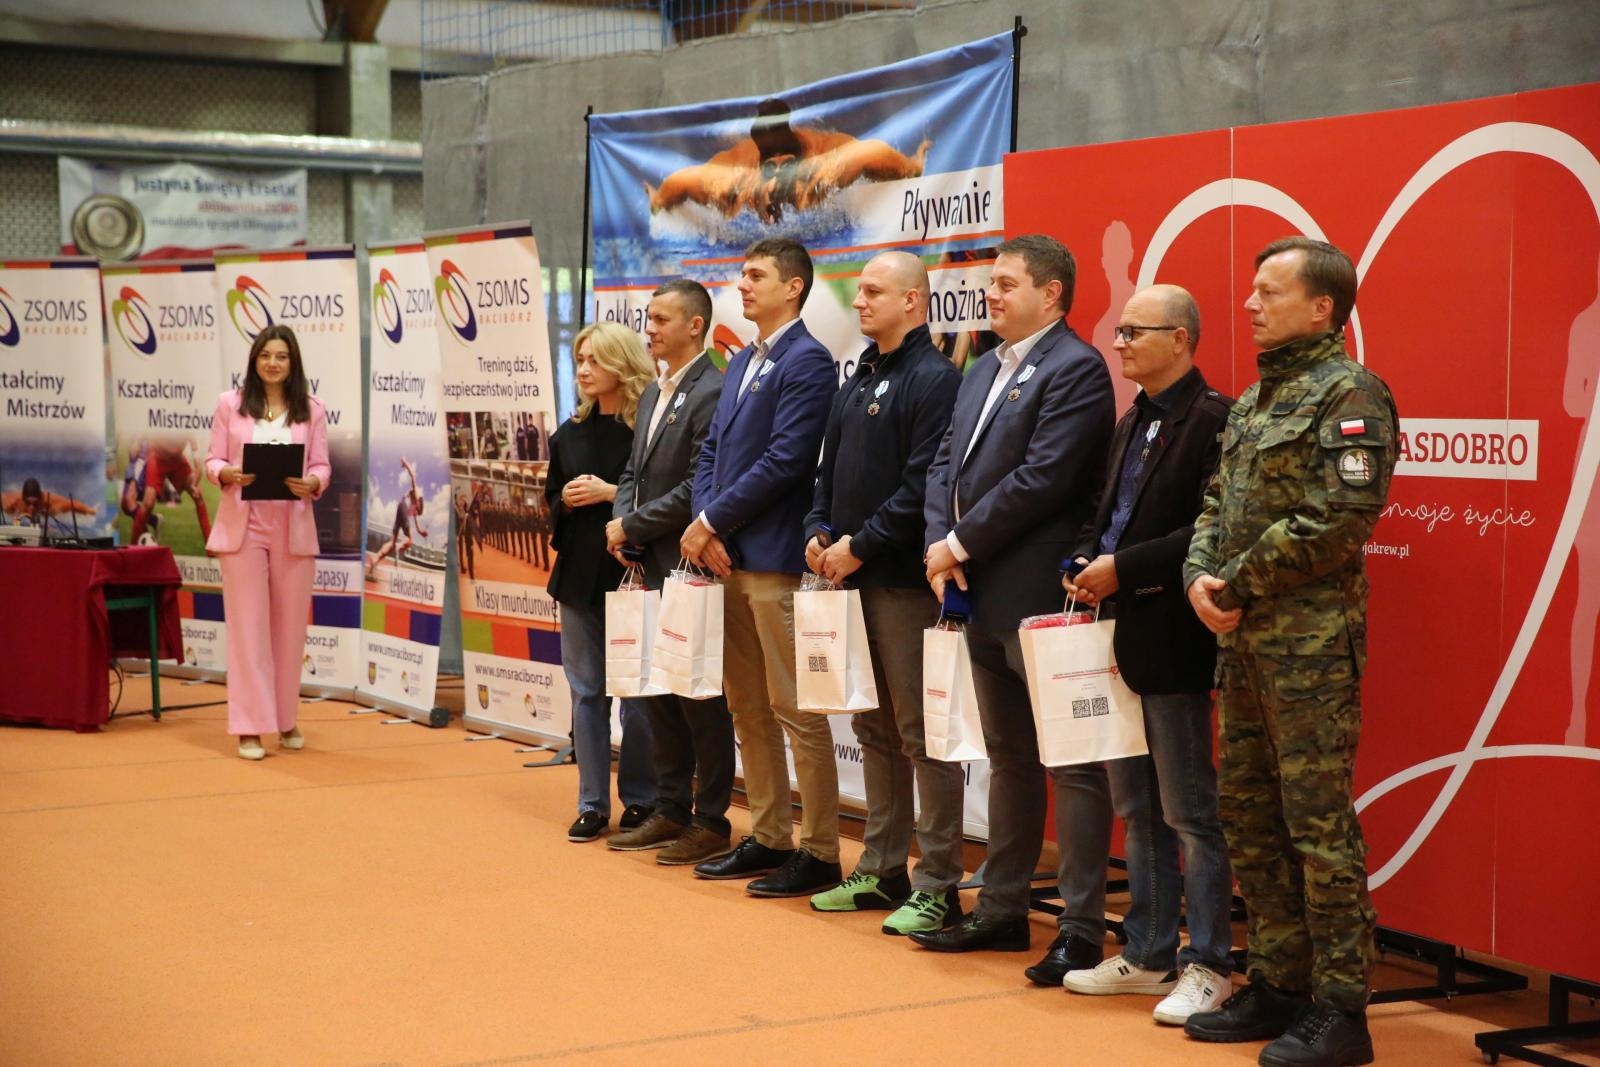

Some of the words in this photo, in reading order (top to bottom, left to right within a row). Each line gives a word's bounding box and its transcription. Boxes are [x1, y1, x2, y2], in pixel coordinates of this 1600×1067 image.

[901, 180, 991, 242] Pływanie
[477, 278, 530, 308] ZSOMS
[929, 279, 988, 323] nożna
[23, 299, 88, 322] ZSOMS
[158, 304, 215, 329] ZSOMS
[280, 294, 344, 319] ZSOMS
[478, 356, 513, 377] Trening
[117, 378, 195, 405] Kształcimy
[372, 369, 426, 400] Kształcimy
[513, 380, 540, 402] jutra
[7, 397, 86, 420] Mistrzów
[148, 408, 214, 430] Mistrzów
[1379, 502, 1456, 534] moje
[1463, 503, 1537, 537] życie
[1362, 541, 1409, 559] jakrew.pl
[475, 584, 500, 616] Klasy
[474, 663, 554, 690] www.smsraciborz.pl
